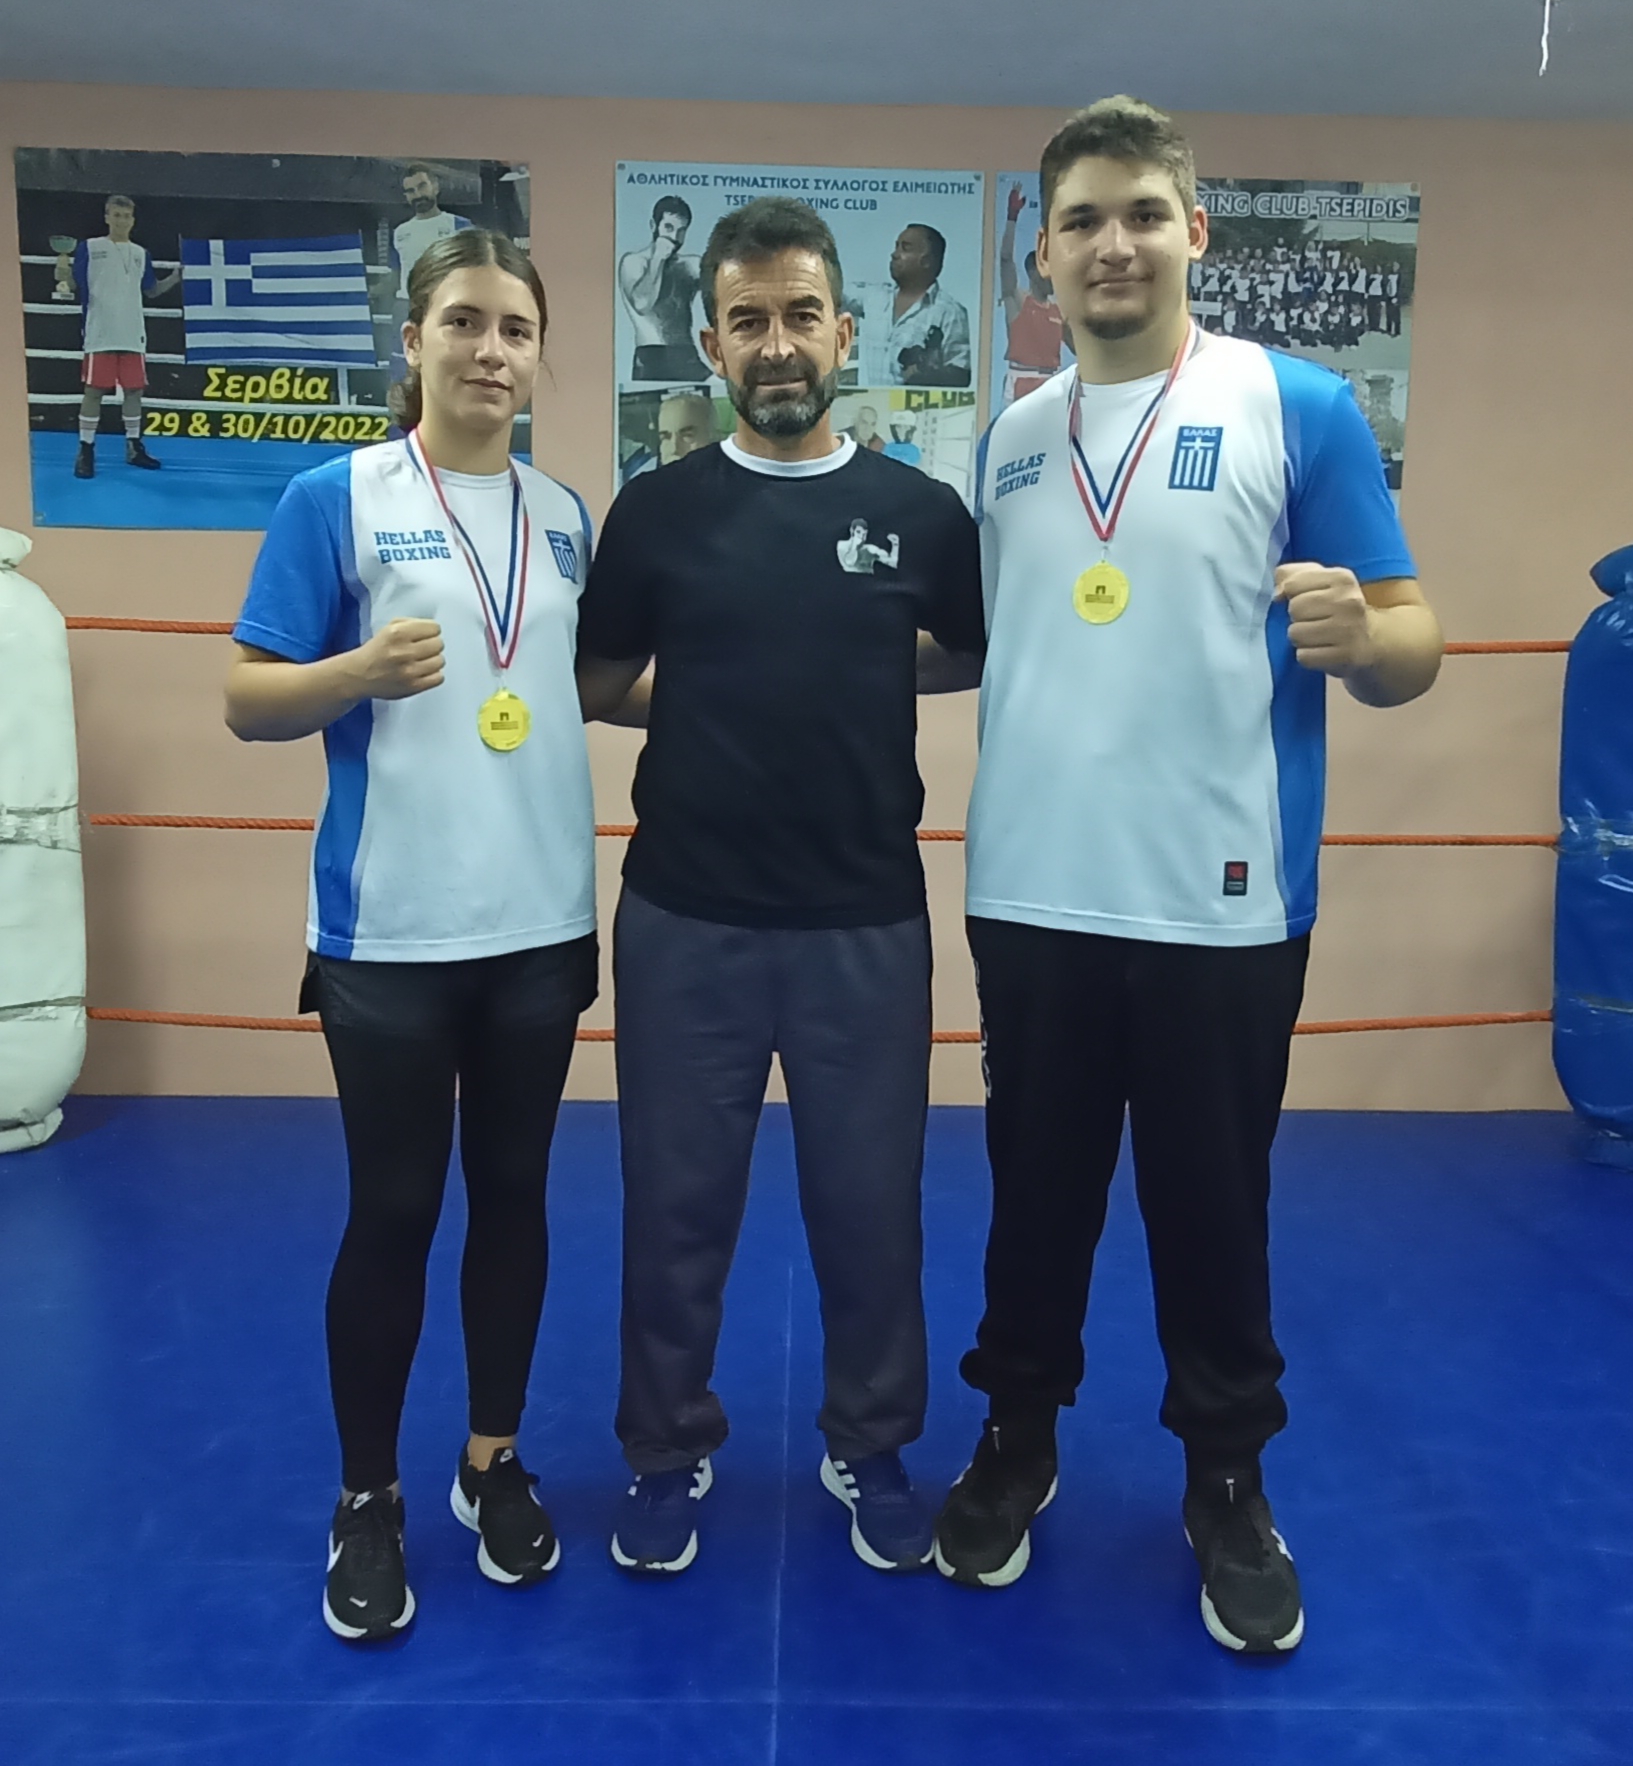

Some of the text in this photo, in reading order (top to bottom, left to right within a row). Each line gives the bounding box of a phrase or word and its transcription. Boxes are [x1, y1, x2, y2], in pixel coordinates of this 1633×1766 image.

[627, 173, 975, 194] ΑΘΛΗΤΙΚΟΣ ΓΥΜΝΑΣΤΙΚΟΣ ΣΥΛΛΟΓΟΣ ΕΛΙΜΕΙΩΤΗΣ
[844, 198, 878, 210] CLUB
[1255, 194, 1310, 217] CLUB
[203, 367, 329, 405] Σερβία
[905, 389, 975, 411] CLUB
[143, 412, 390, 444] 29 & 30/10/2022
[996, 452, 1047, 482] HELLAS
[995, 470, 1041, 501] BOXING
[374, 529, 446, 546] HELLAS
[378, 545, 452, 565] BOXING
